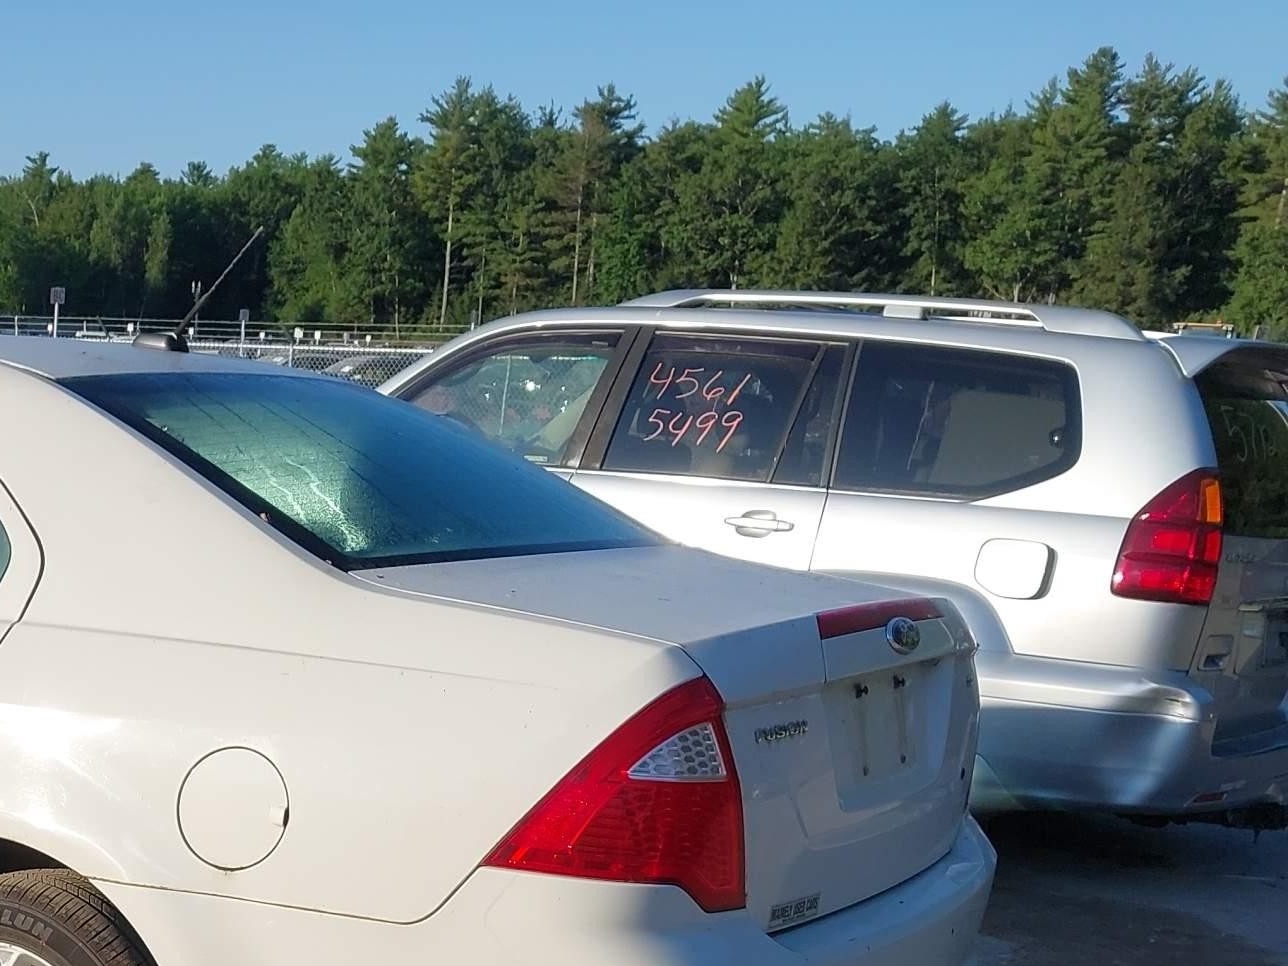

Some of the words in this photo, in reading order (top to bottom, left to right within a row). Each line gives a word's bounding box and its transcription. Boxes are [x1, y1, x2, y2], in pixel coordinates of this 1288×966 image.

[649, 361, 752, 406] 4561
[643, 407, 744, 453] 5499
[754, 720, 809, 744] FUSION
